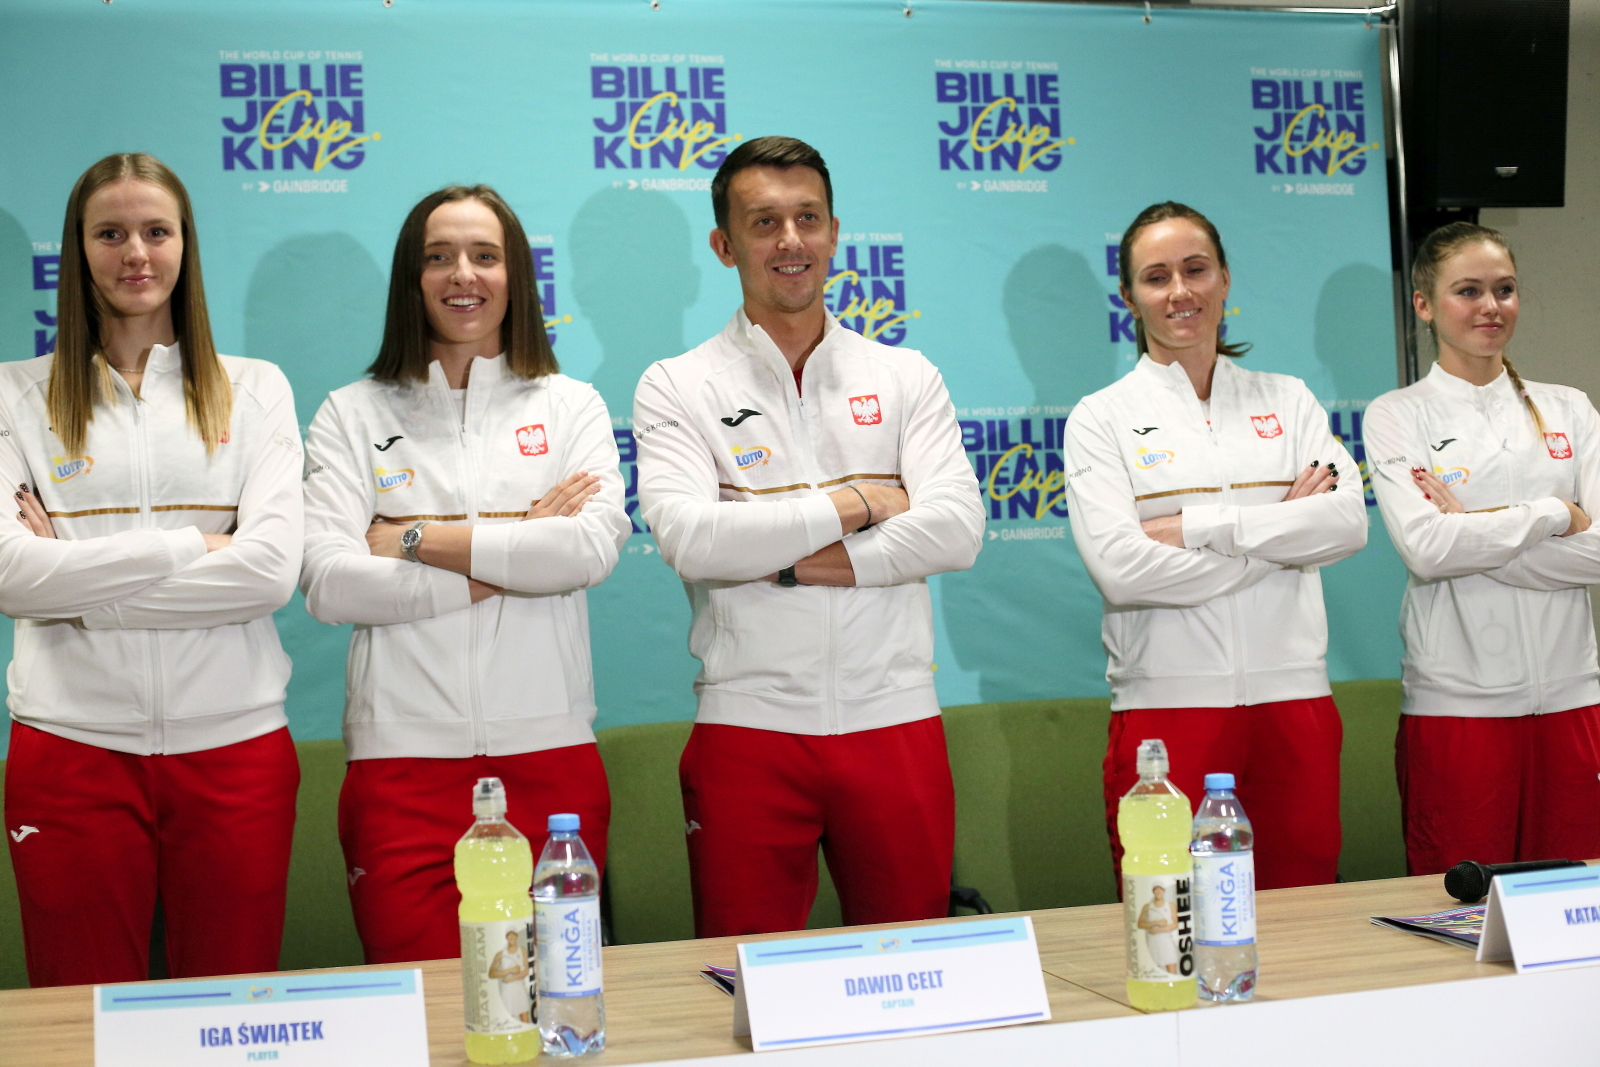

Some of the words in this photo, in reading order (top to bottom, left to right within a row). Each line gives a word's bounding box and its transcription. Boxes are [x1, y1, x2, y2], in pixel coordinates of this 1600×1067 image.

[219, 51, 239, 60] THE
[242, 51, 280, 60] WORLD
[283, 51, 304, 60] CUP
[307, 51, 321, 60] OF
[325, 51, 363, 60] TENNIS
[590, 53, 608, 62] THE
[612, 53, 648, 62] WORLD
[649, 54, 670, 62] CUP
[672, 54, 685, 63] OF
[688, 54, 724, 64] TENNIS
[935, 59, 952, 68] THE
[955, 60, 988, 68] WORLD
[990, 61, 1009, 69] CUP
[1011, 61, 1022, 69] OF
[1026, 61, 1058, 70] TENNIS
[220, 64, 363, 97] BILLIE
[591, 66, 724, 99] BILLIE
[1250, 67, 1266, 76] THE
[1320, 69, 1330, 78] OF
[936, 72, 1059, 104] BILLIE
[1252, 79, 1364, 111] BILLIE
[222, 100, 364, 133] JEAN
[593, 101, 726, 134] JEAN
[938, 106, 1061, 137] JEAN
[1253, 112, 1365, 143] JEAN
[259, 89, 381, 172] Cup
[628, 91, 742, 170] Cup
[971, 96, 1076, 173] Cup
[1284, 104, 1380, 177] Cup
[222, 137, 365, 170] KING
[594, 136, 727, 169] KING
[939, 139, 1062, 171] KING
[1255, 144, 1366, 175] KING
[273, 179, 348, 192] GAINBRIDGE
[641, 178, 711, 191] GAINBRIDGE
[983, 180, 1048, 192] GAINBRIDGE
[1296, 183, 1354, 195] GAINBRIDGE
[32, 242, 52, 251] THE
[827, 246, 904, 277] LLIE
[972, 407, 1004, 416] WORLD
[1006, 406, 1026, 415] CUP
[651, 420, 679, 431] KRONO
[57, 460, 85, 477] LOTTO
[735, 450, 763, 466] LOTTO
[1141, 453, 1167, 466] LOTTO
[379, 472, 407, 488] LOTTO
[1437, 470, 1463, 484] OTTO
[1001, 527, 1066, 541] GAINBRIDGE
[1176, 877, 1194, 977] OSHEE
[1564, 906, 1600, 926] KATA
[845, 974, 903, 996] DAWID
[907, 970, 943, 991] CELT
[881, 999, 915, 1010] CAPTAIN
[200, 1026, 232, 1047] IGA
[238, 1021, 324, 1046] ŚWIĄTEK
[247, 1050, 279, 1061] PLAYER
